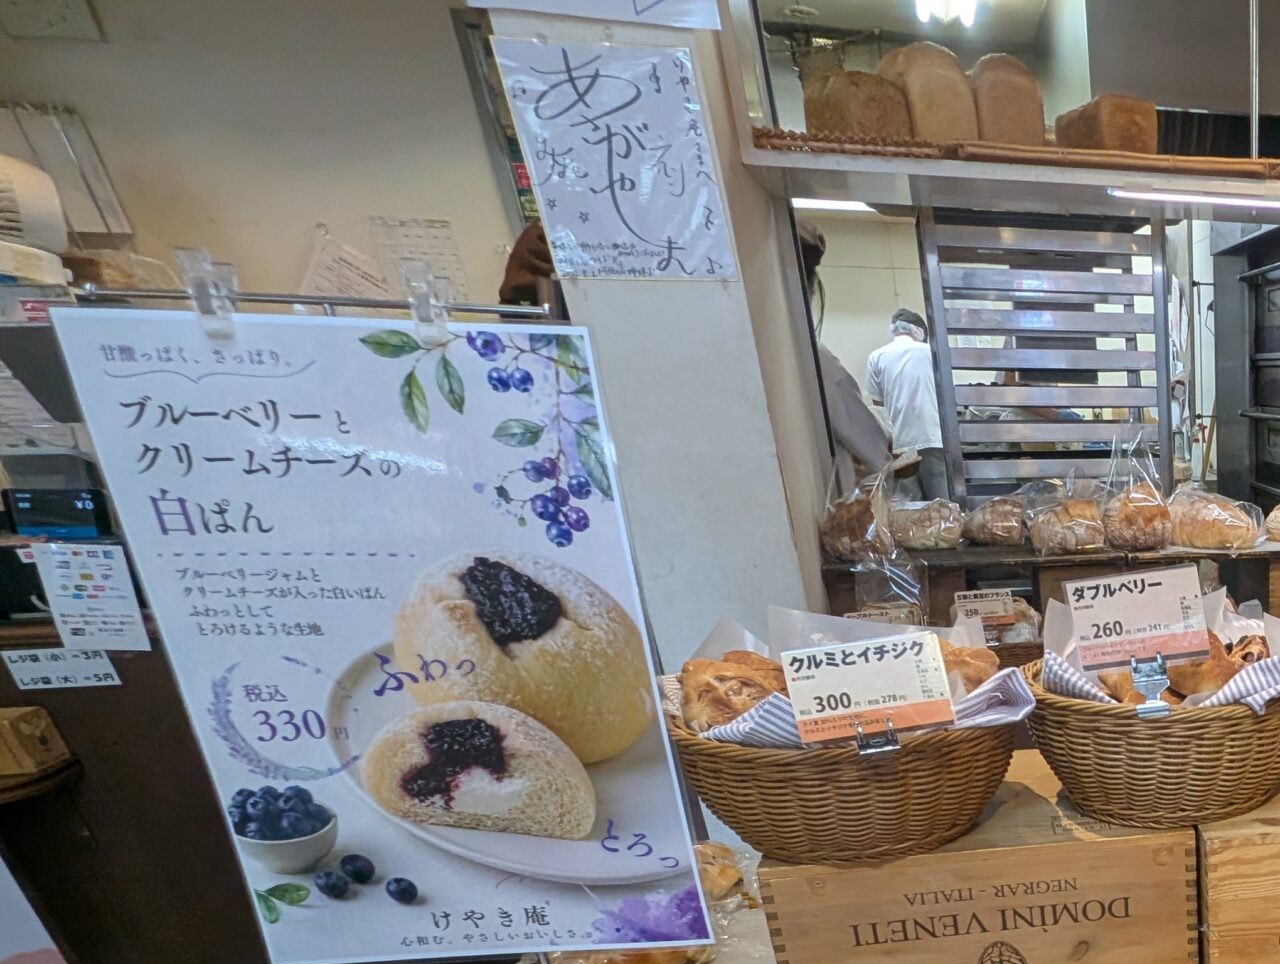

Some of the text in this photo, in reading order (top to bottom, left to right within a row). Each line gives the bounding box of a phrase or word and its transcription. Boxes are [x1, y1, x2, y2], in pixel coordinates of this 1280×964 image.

[149, 487, 274, 535] 白ぱん
[1072, 578, 1163, 603] ダブルベリー
[189, 603, 275, 618] ふわっとして
[198, 622, 325, 637] とろけるような生地
[1091, 620, 1123, 639] 260
[788, 640, 924, 674] クルミとイチジク
[372, 651, 477, 697] ふわっ
[242, 684, 288, 702] 税込
[813, 692, 852, 714] 300
[252, 709, 326, 743] 330
[600, 818, 680, 869] とろっ
[904, 887, 974, 907] ITALIA
[992, 878, 1078, 898] NEGRAR
[430, 904, 550, 931] けやき庵
[849, 912, 990, 948] VENETI
